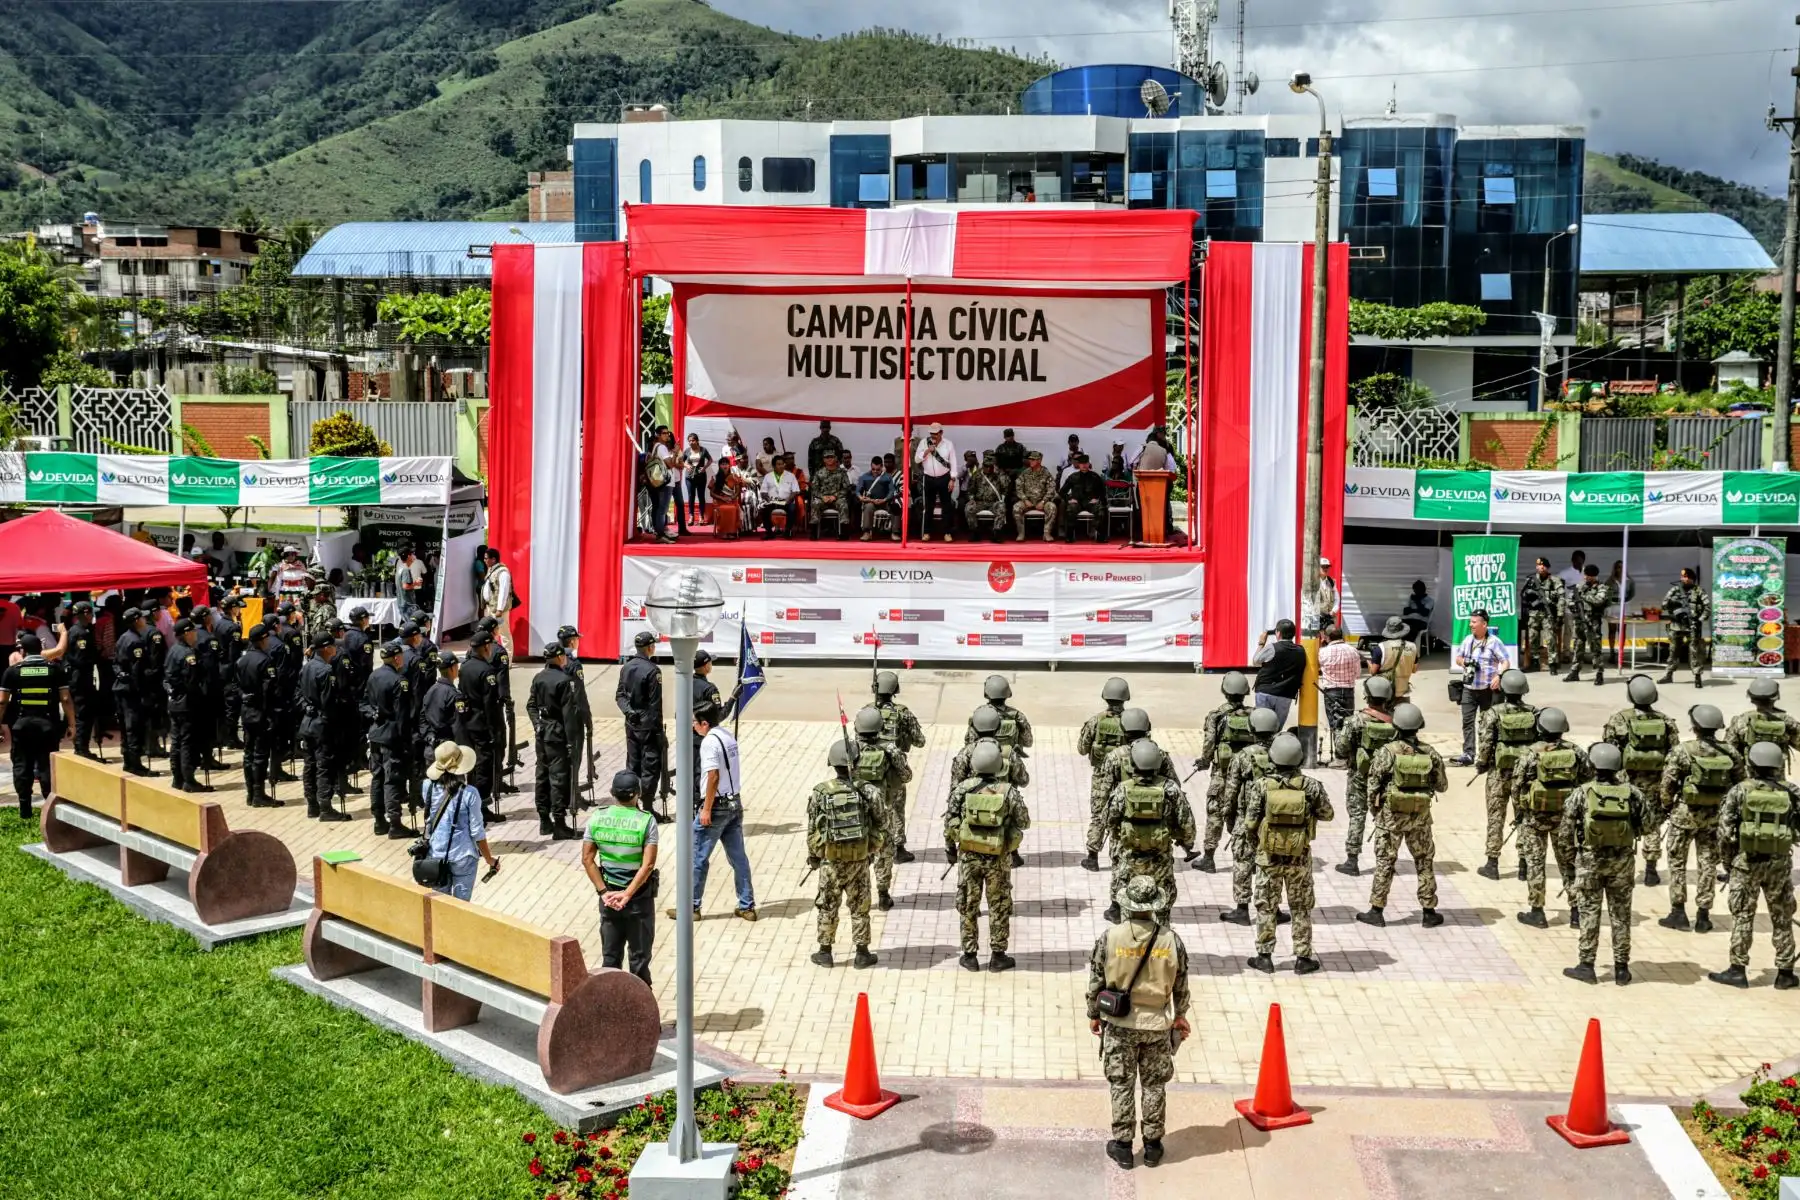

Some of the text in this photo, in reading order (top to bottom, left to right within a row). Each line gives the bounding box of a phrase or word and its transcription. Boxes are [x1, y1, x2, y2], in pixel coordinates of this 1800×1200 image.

[787, 298, 1049, 342] CAMPAÑA CÍVICA
[787, 343, 1047, 382] MULTISECTORIAL
[46, 472, 95, 482] DEVIDA
[117, 474, 165, 485] DEVIDA
[188, 476, 236, 486] DEVIDA
[260, 476, 306, 486] DEVIDA
[329, 475, 376, 485] DEVIDA
[400, 474, 445, 483] DEVIDA
[1360, 486, 1410, 497] DEVIDA
[1435, 489, 1487, 499] DEVIDA
[1511, 491, 1562, 501] DEVIDA
[1587, 493, 1640, 503] DEVIDA
[1665, 493, 1718, 503] DEVIDA
[1744, 493, 1797, 502] DEVIDA
[374, 512, 405, 520] DEVIDA
[1465, 553, 1506, 565] PRODUCTO
[879, 570, 933, 580] DEVIDA
[1464, 561, 1507, 583] 100%
[1457, 585, 1510, 601] HECHO EN
[1470, 598, 1511, 614] VRAEM
[719, 610, 739, 620] alud
